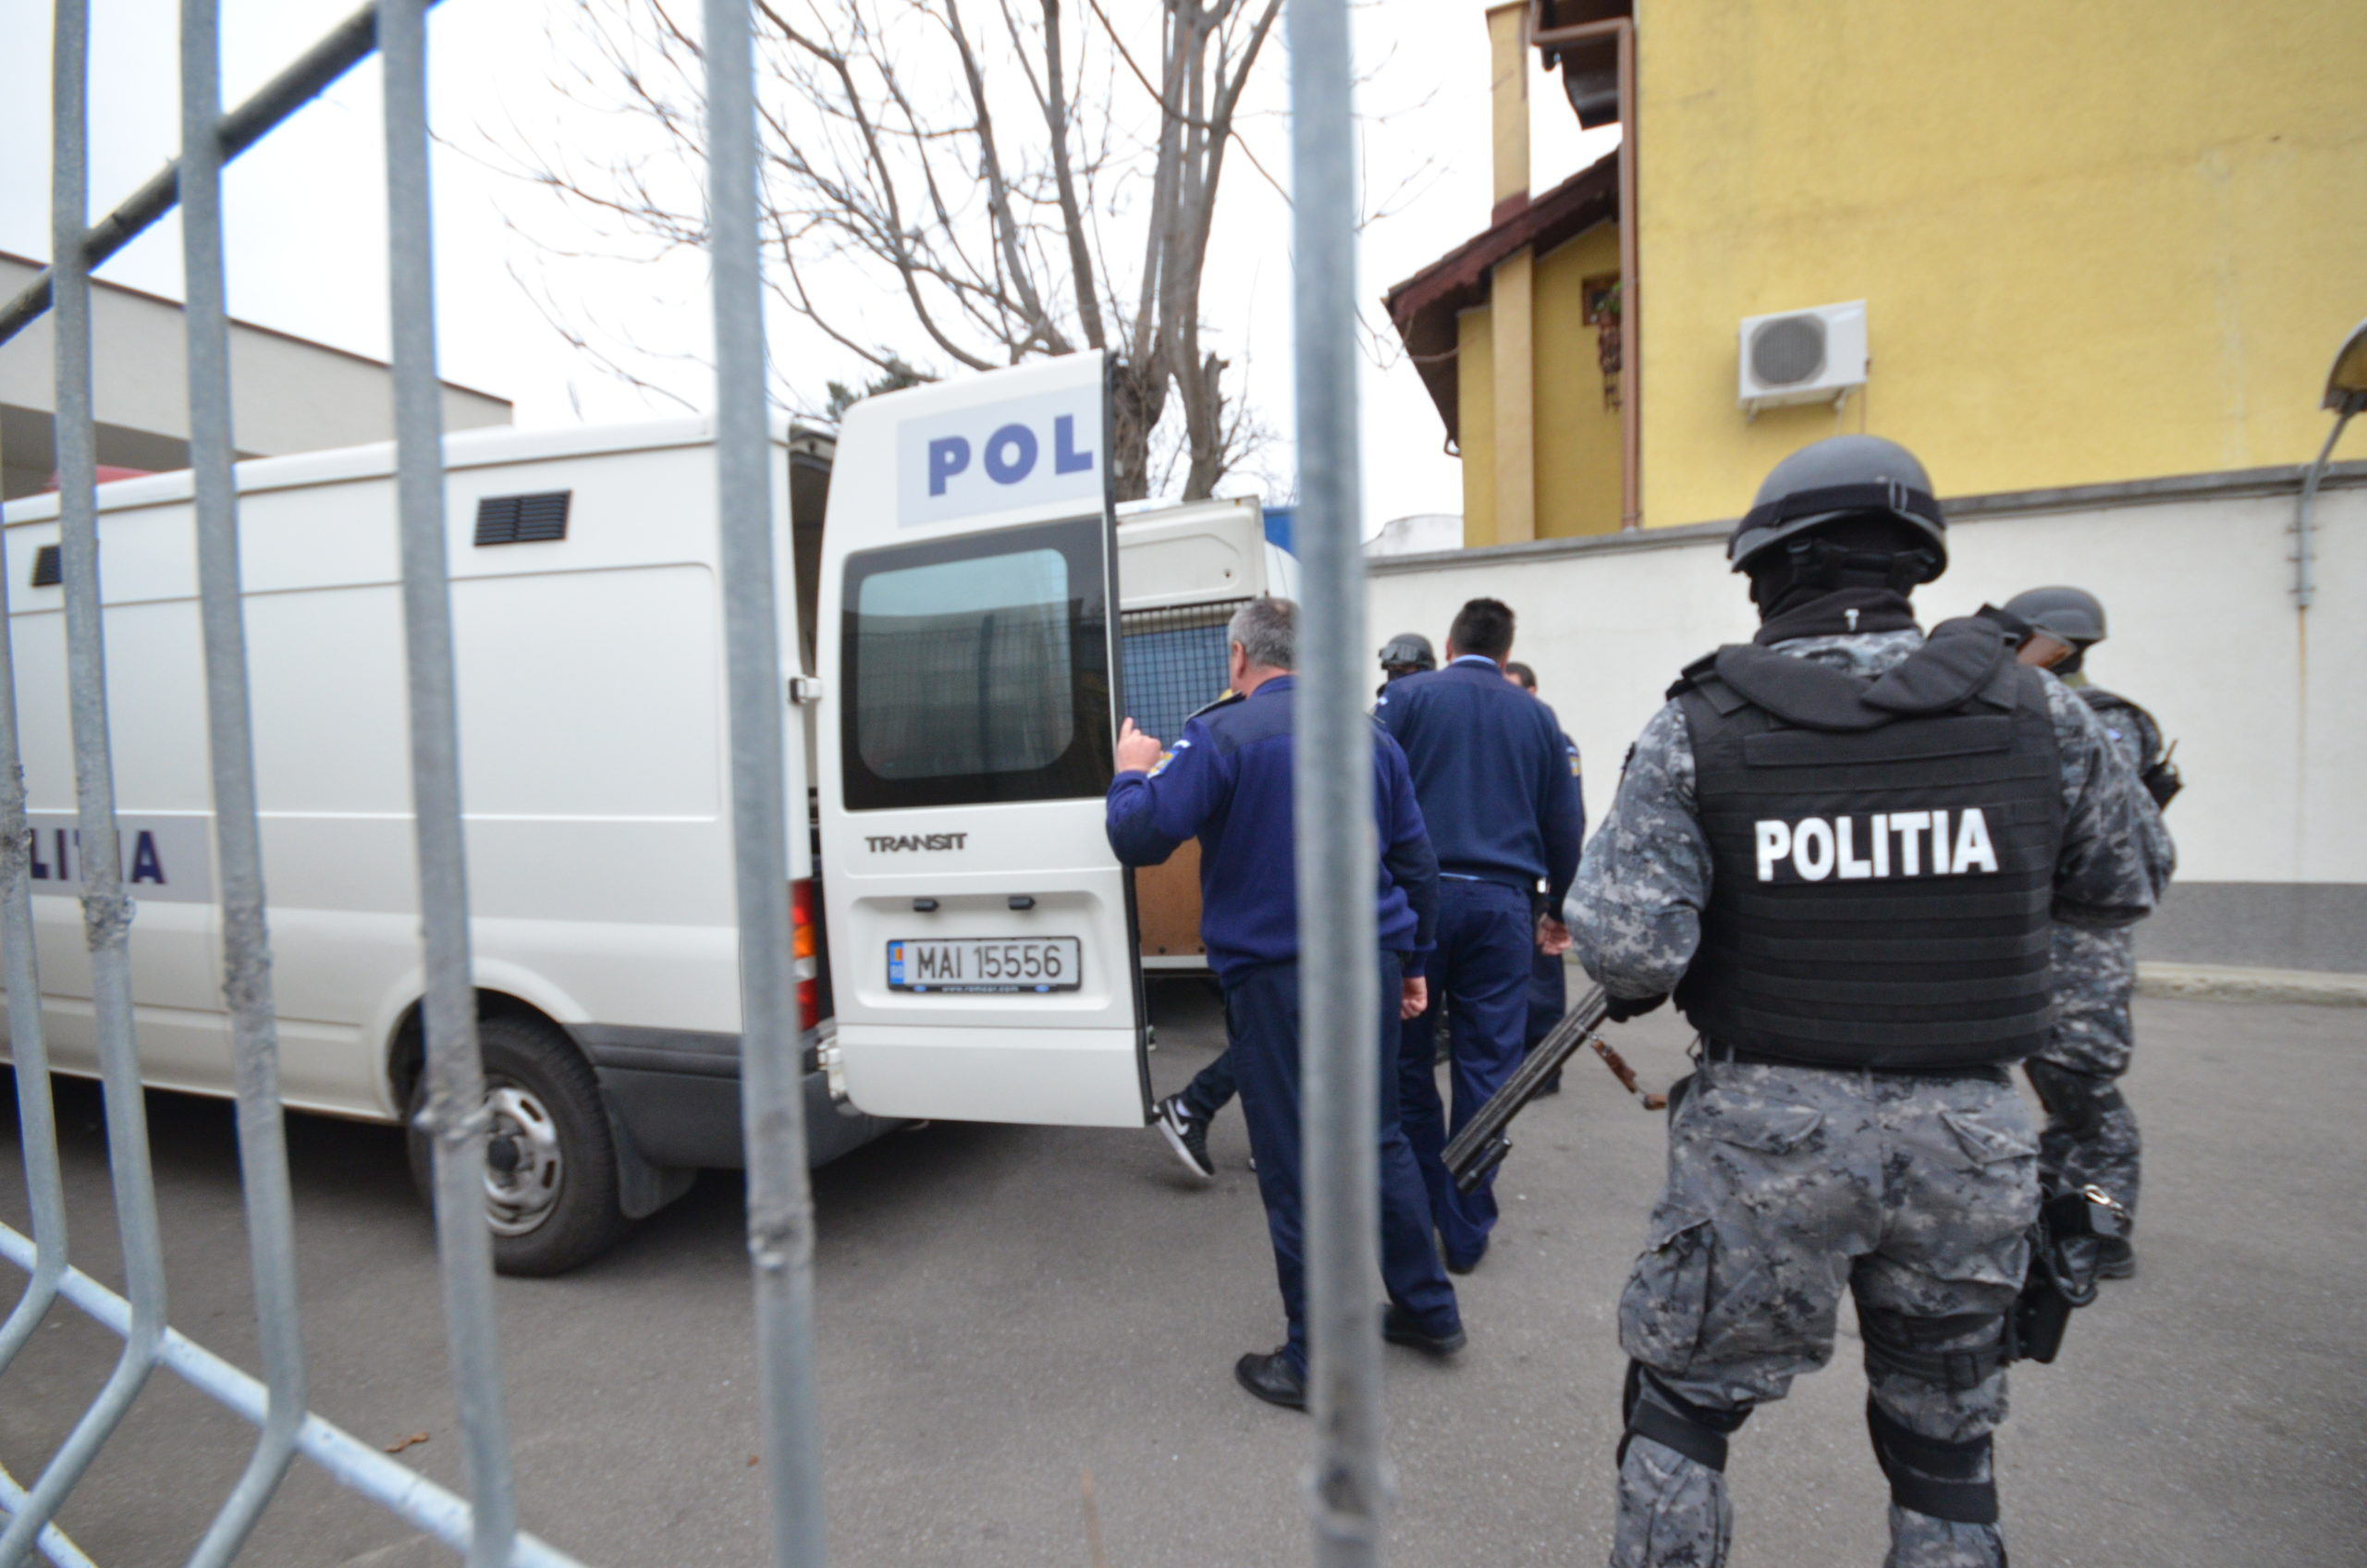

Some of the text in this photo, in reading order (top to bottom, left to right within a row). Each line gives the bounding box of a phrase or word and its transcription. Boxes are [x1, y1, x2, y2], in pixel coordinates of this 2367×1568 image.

[928, 413, 1094, 497] POL
[29, 827, 167, 885] LIA
[865, 832, 968, 853] TRANSIT
[1755, 807, 2000, 883] POLITIA
[916, 943, 1062, 980] MAI 15556
